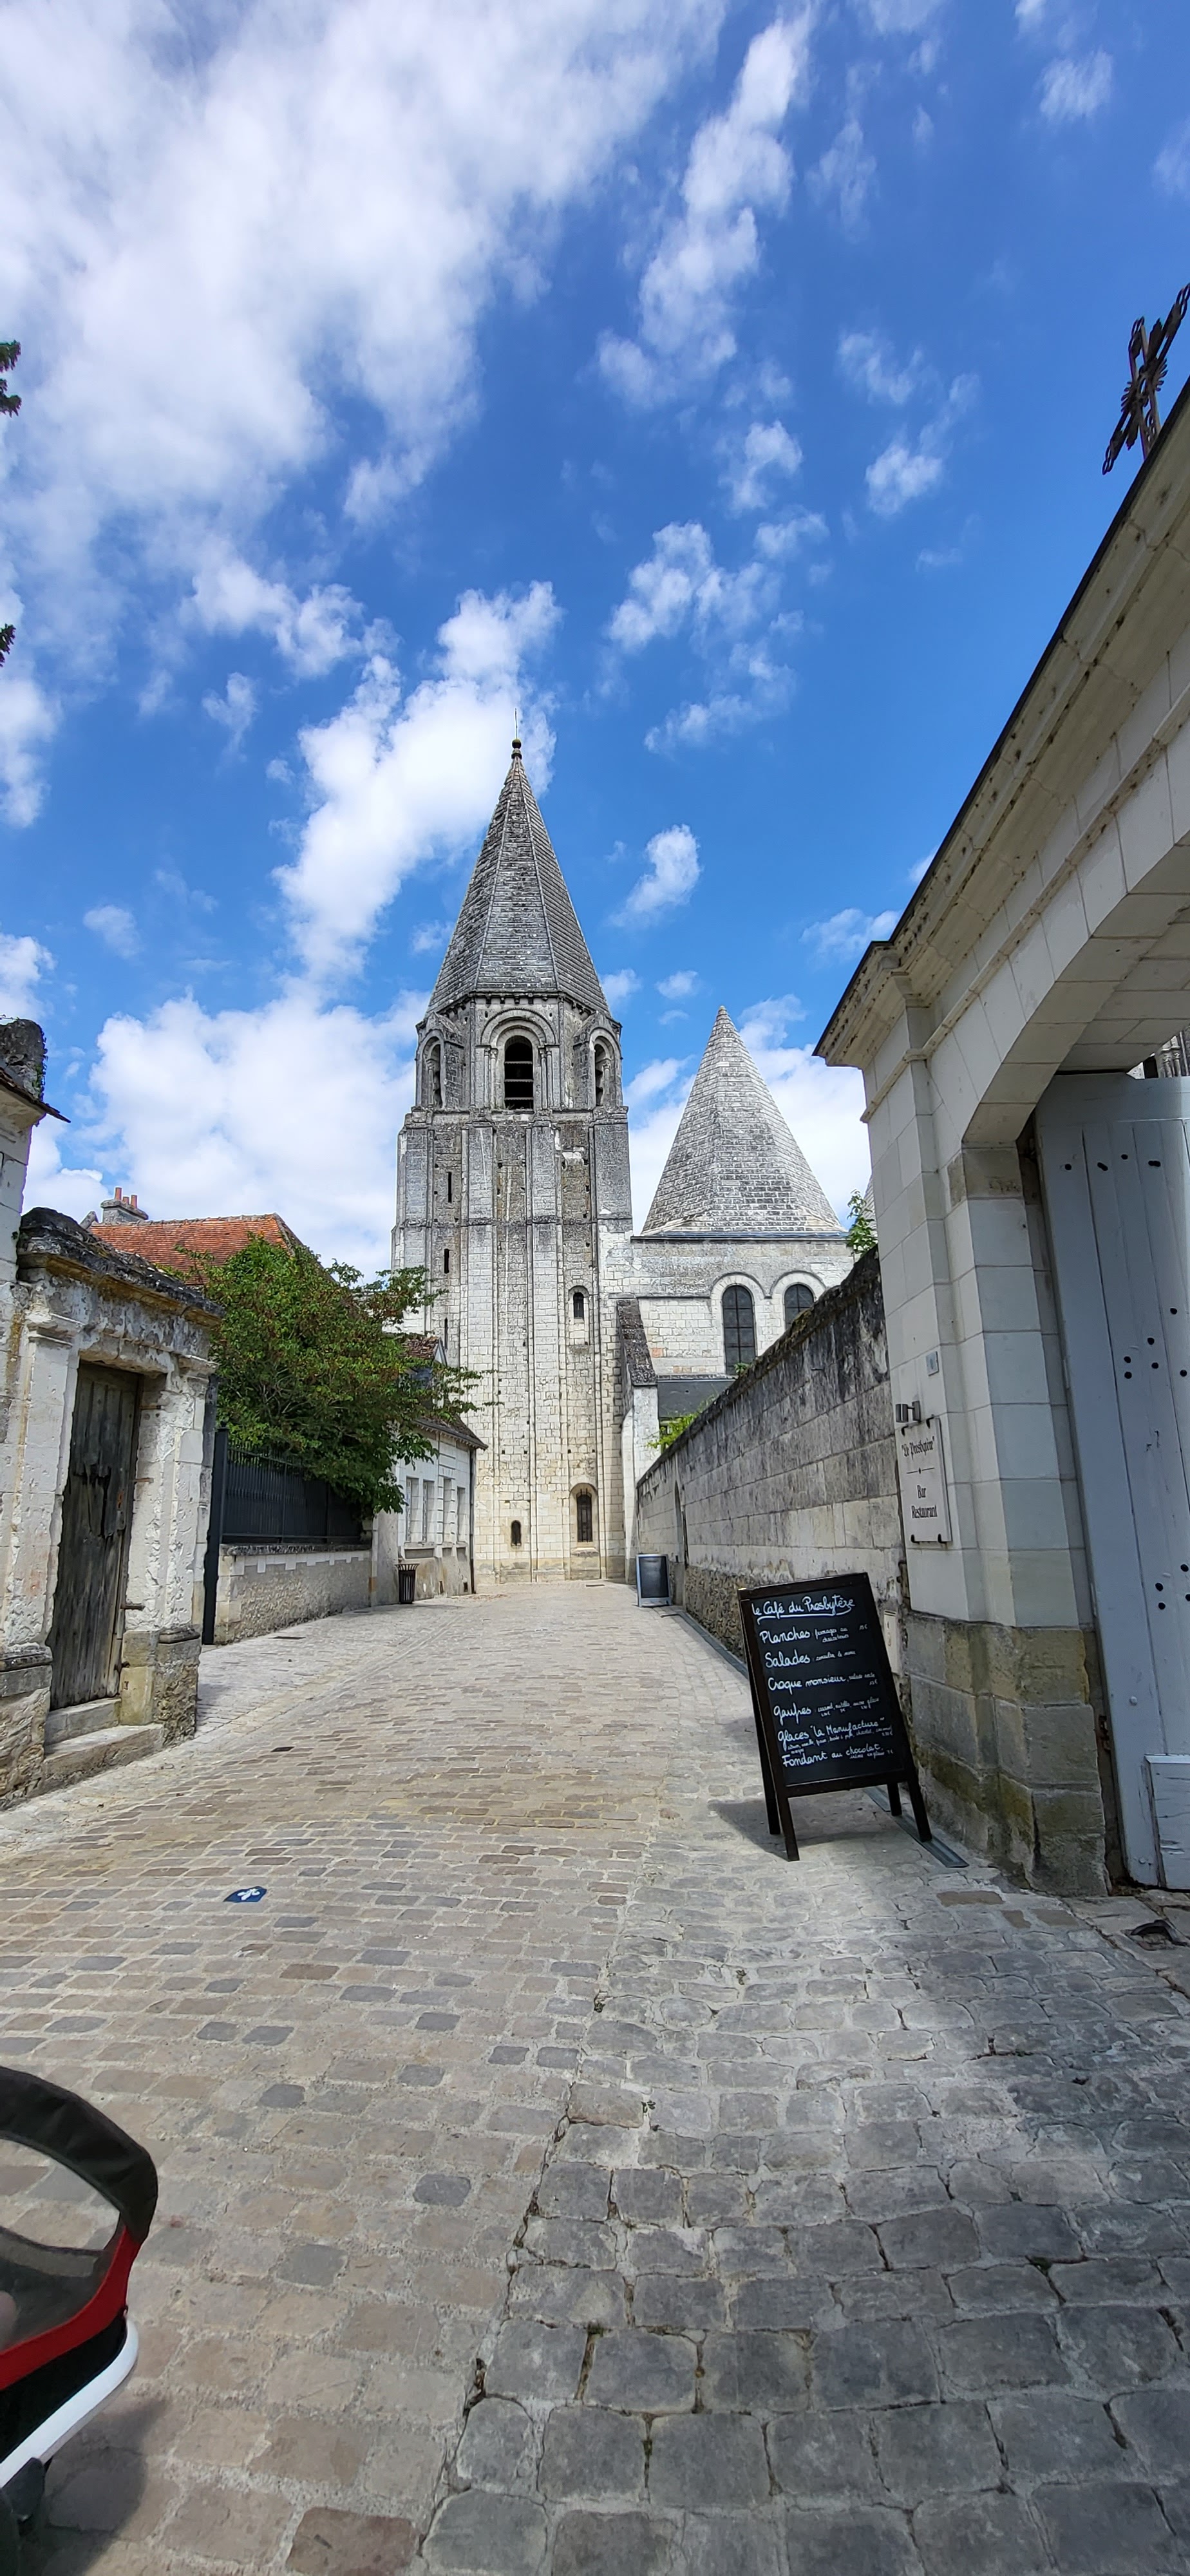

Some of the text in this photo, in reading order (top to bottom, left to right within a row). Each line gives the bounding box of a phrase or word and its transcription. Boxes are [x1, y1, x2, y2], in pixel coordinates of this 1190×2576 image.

[917, 1484, 927, 1499] Bar
[911, 1504, 938, 1519] Restaurant
[762, 1601, 784, 1619] Café
[789, 1600, 804, 1614] du
[802, 1594, 856, 1616] Presbytère
[759, 1626, 811, 1644] Planches
[764, 1649, 811, 1668] Salades
[768, 1676, 803, 1695] Croque
[782, 1752, 828, 1768] Fondant
